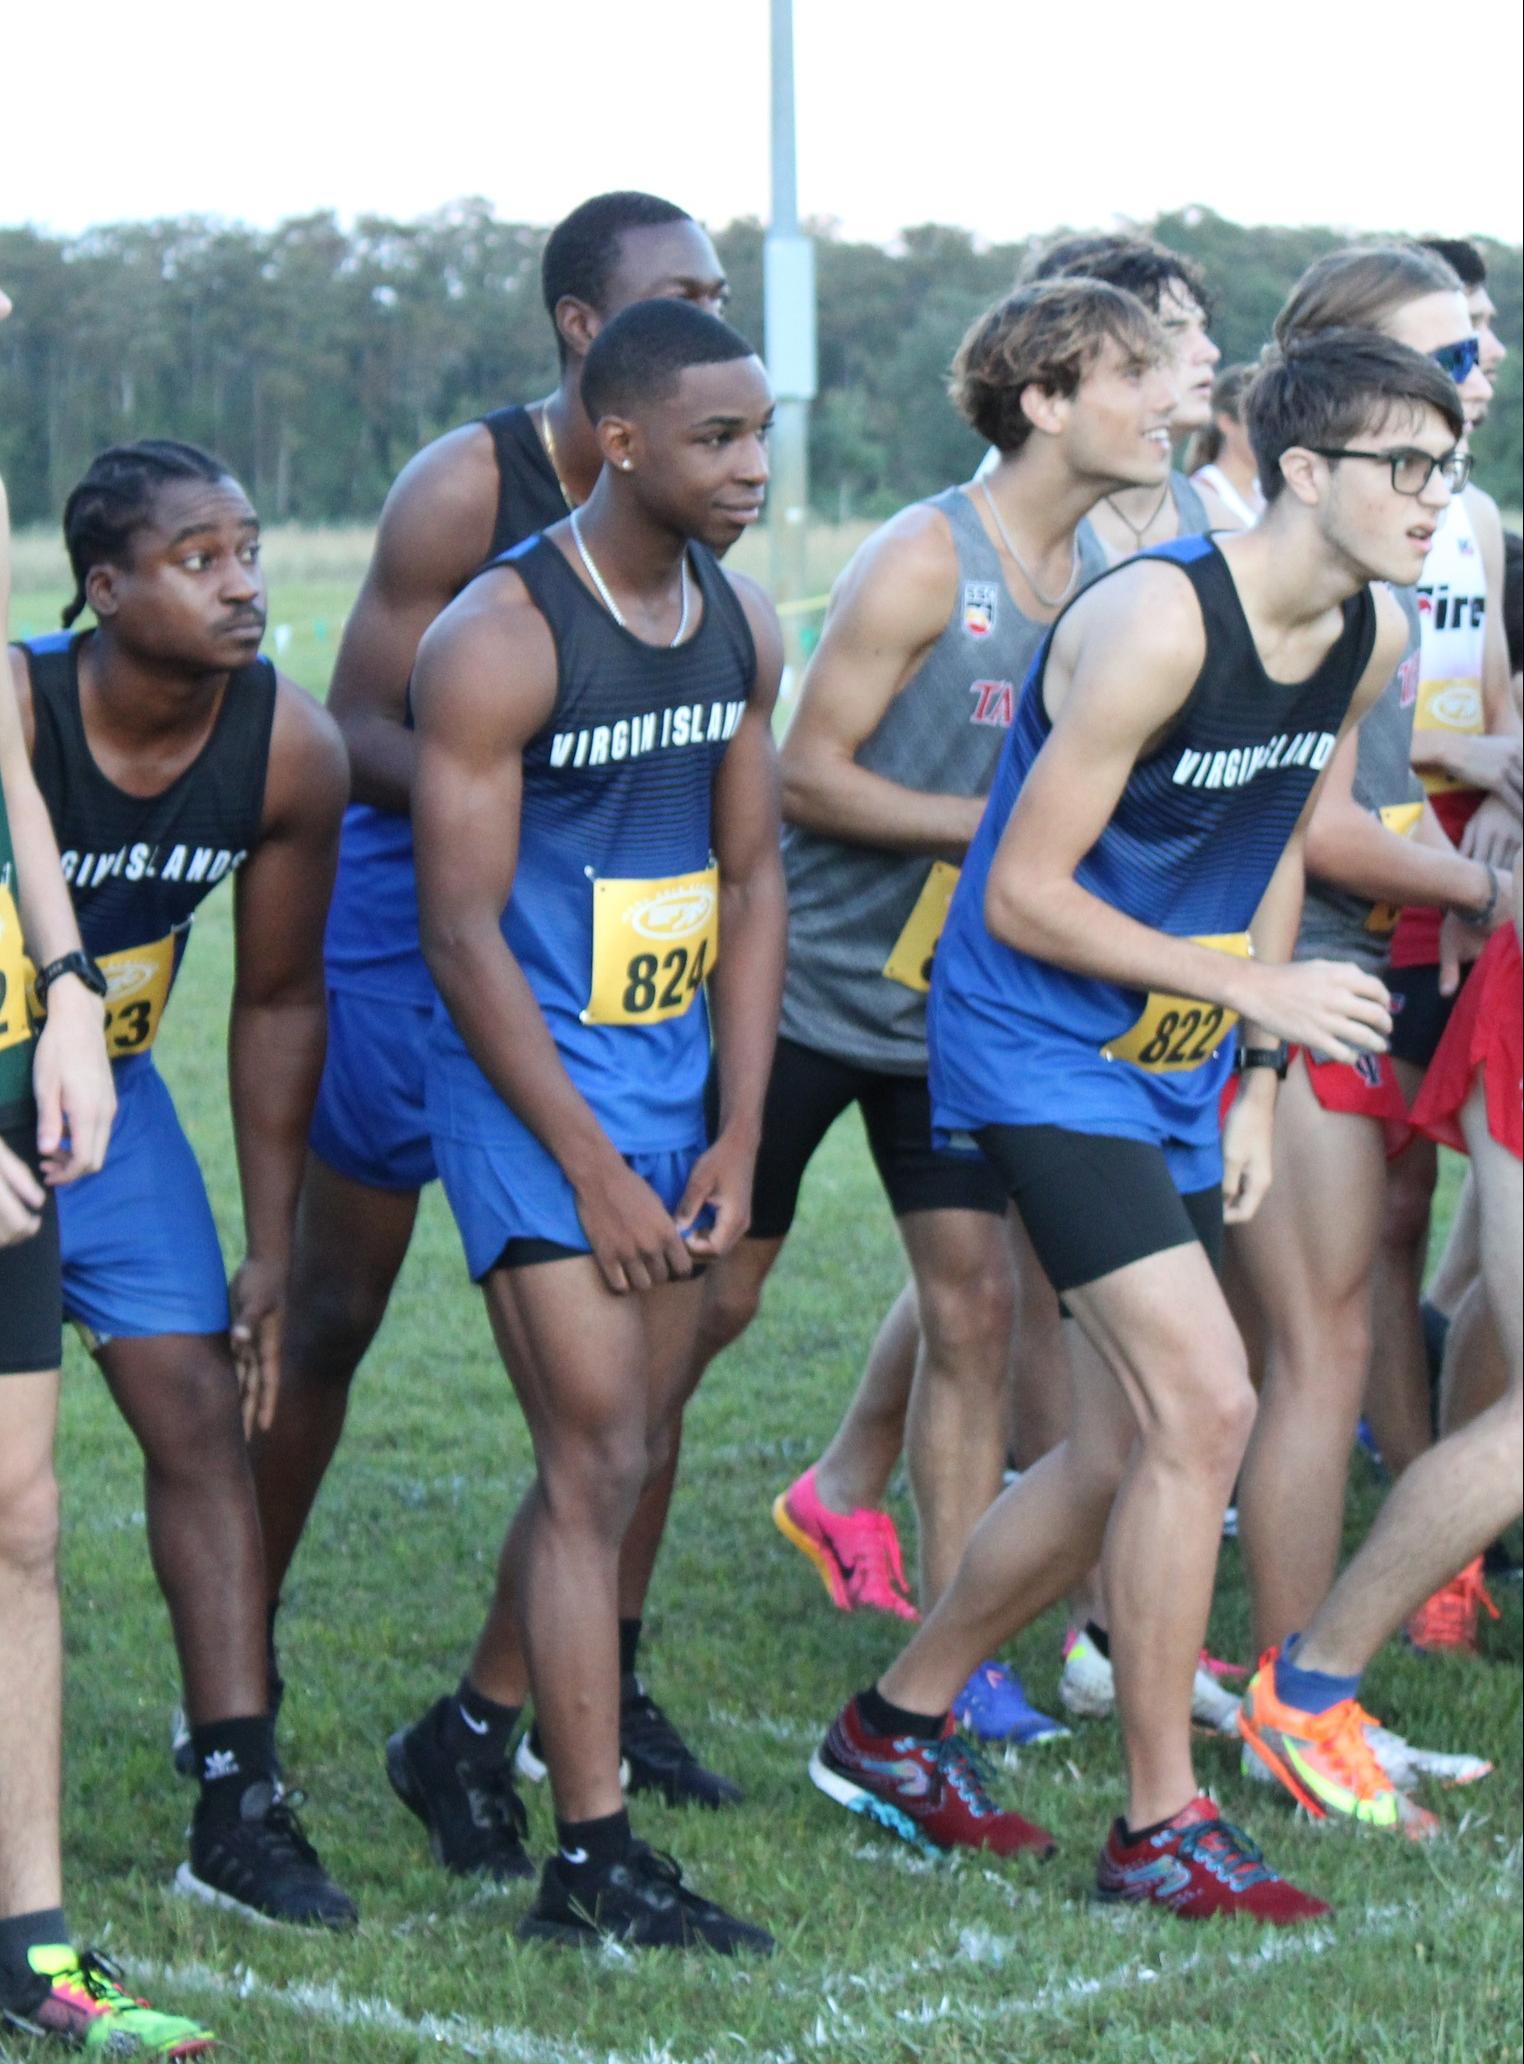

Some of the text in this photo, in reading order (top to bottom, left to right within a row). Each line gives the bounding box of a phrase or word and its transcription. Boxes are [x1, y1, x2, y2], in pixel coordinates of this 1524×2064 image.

[550, 712, 658, 768] VIRGIN
[623, 936, 708, 1014] 824
[1138, 1007, 1224, 1063] 822
